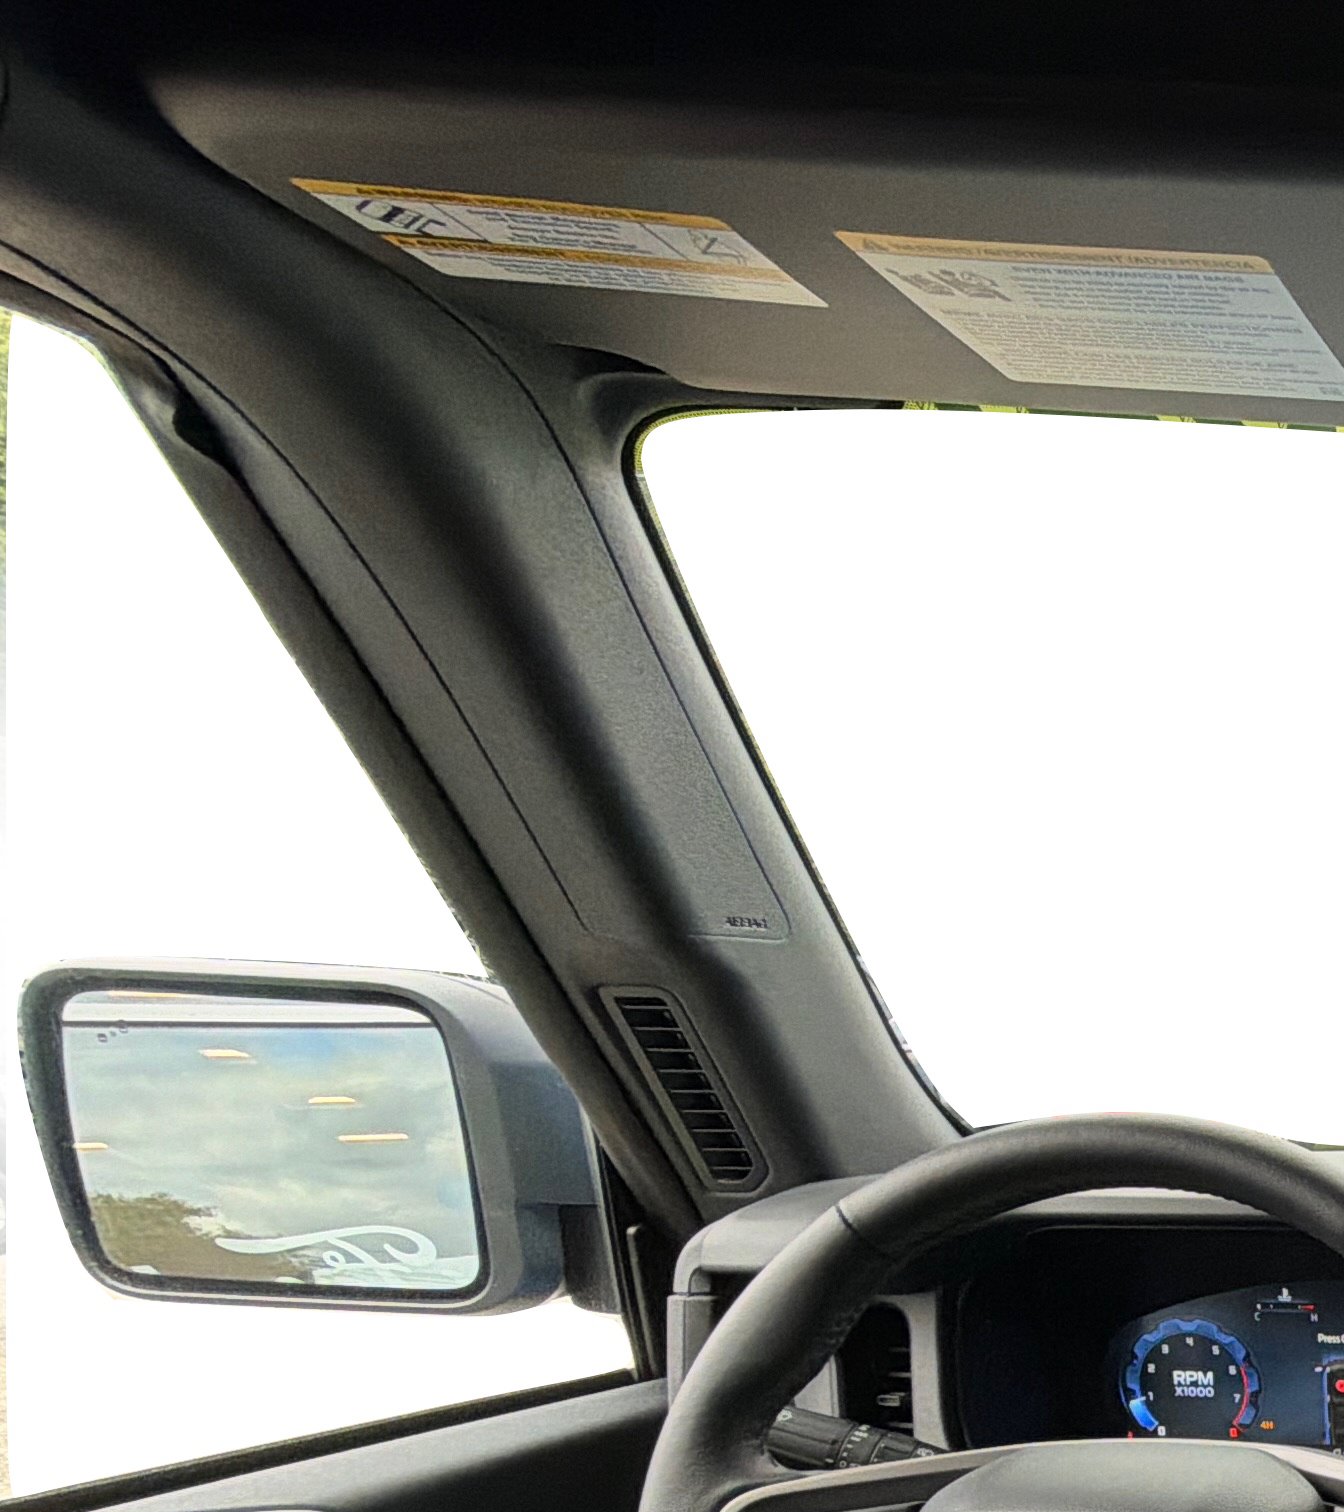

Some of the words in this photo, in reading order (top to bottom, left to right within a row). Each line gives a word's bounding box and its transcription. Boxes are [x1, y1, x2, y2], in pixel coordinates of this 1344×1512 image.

[1310, 1313, 1319, 1322] H
[1185, 1336, 1194, 1347] 4
[1317, 1333, 1340, 1343] Press
[1147, 1363, 1156, 1373] 2
[1172, 1370, 1214, 1386] RPM
[1148, 1391, 1154, 1401] 1
[1233, 1393, 1241, 1403] 7
[1260, 1420, 1274, 1430] 4H
[1157, 1426, 1167, 1436] 0
